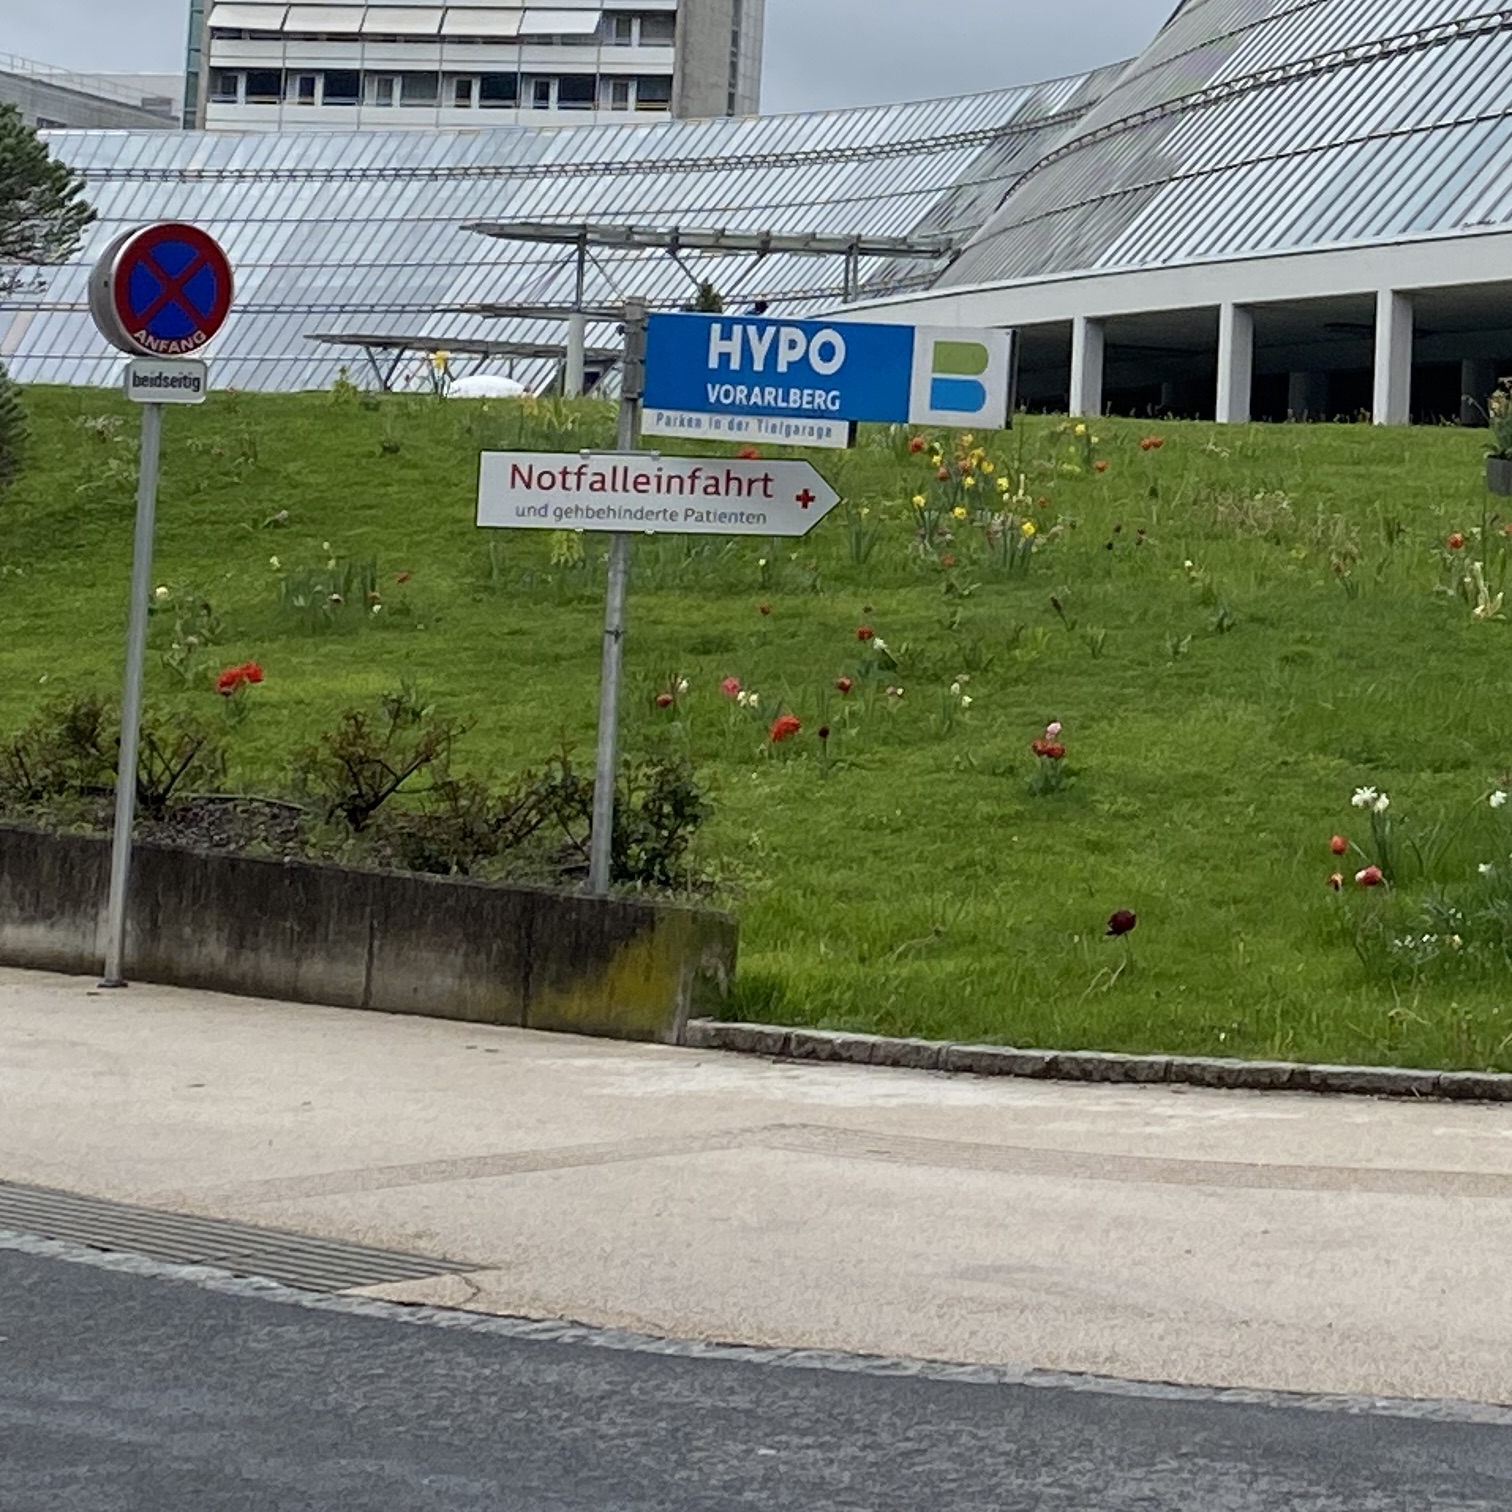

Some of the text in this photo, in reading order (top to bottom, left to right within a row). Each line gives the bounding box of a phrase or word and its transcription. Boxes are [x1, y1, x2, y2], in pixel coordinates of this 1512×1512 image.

[133, 329, 207, 354] ANFANG
[708, 322, 846, 375] HYPO
[131, 370, 201, 393] beidseitig
[706, 383, 840, 411] VORARLBERG
[655, 411, 702, 429] Parken
[727, 416, 750, 432] der
[509, 463, 774, 499] Notfalleinfahrt
[515, 503, 767, 526] und gehbehinderte Patienten
